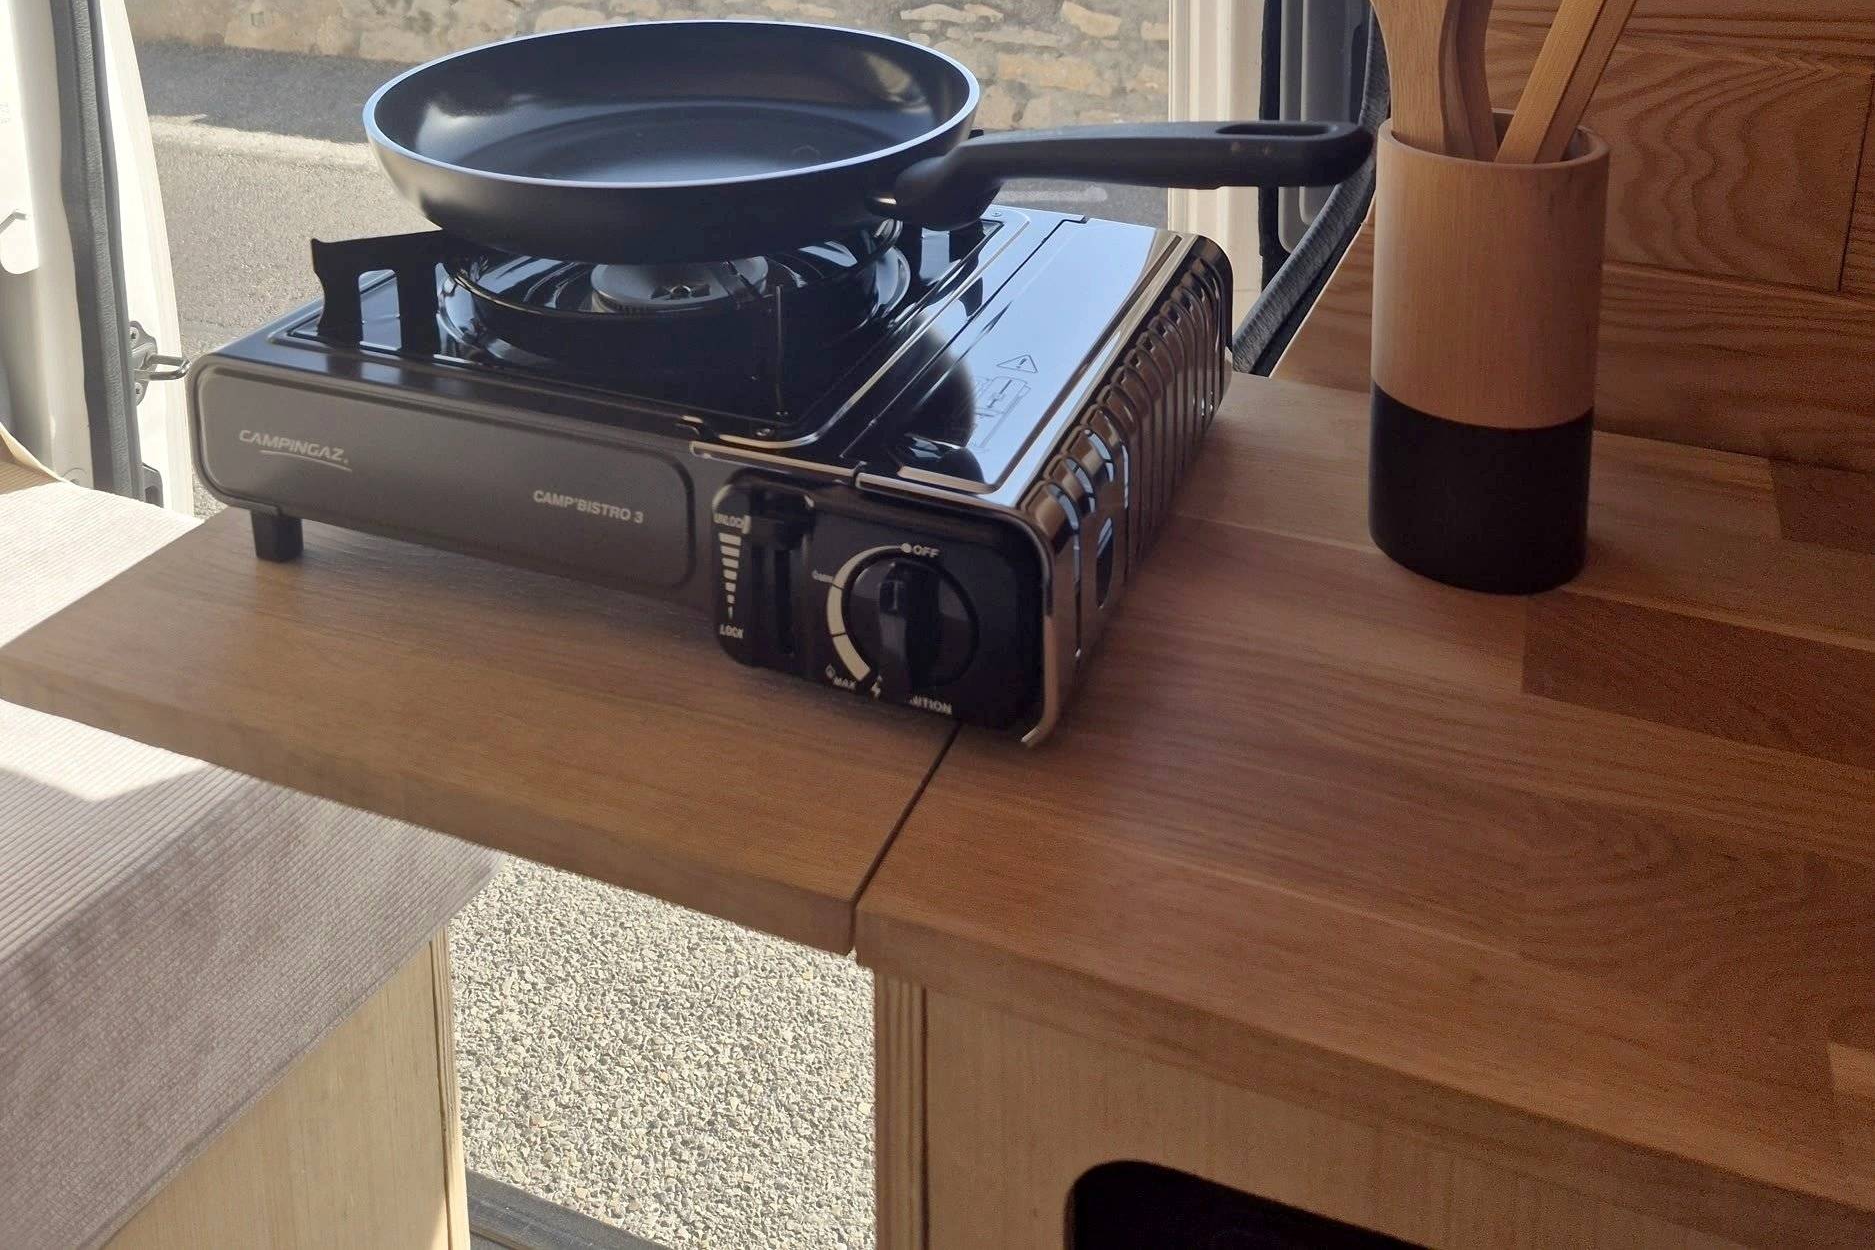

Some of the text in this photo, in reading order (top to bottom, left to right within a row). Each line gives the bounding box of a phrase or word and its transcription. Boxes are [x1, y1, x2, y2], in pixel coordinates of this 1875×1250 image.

[239, 430, 345, 462] CAMPINGAZ
[533, 490, 644, 524] CAMP'BISTRO 3
[713, 513, 745, 529] UNLOC
[913, 544, 940, 557] OFF
[719, 624, 744, 639] LOCK
